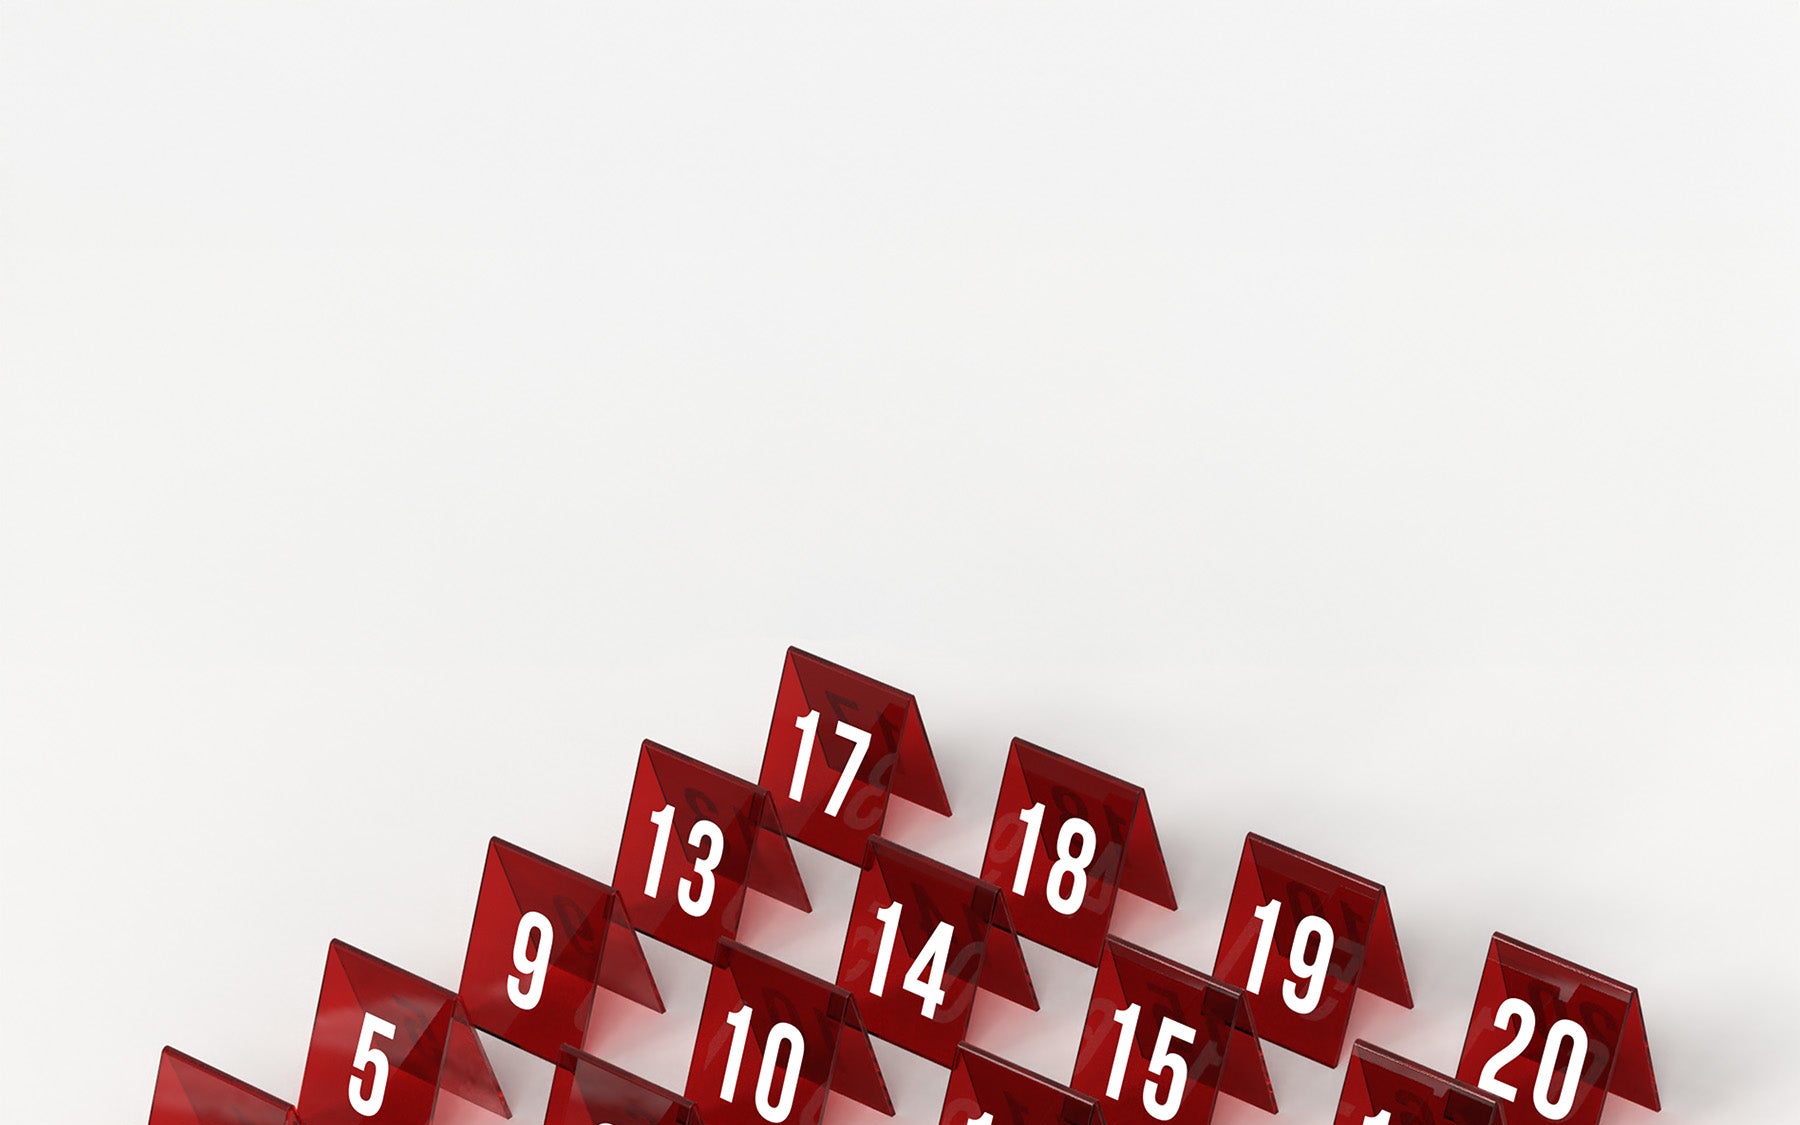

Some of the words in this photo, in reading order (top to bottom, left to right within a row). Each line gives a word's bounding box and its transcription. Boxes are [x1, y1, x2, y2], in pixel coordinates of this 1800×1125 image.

[788, 709, 872, 817] 17
[644, 804, 724, 917] 13
[1012, 802, 1097, 915] 18
[506, 911, 554, 1010] 9
[869, 901, 955, 1020] 14
[1245, 898, 1335, 1015] 19
[348, 1011, 397, 1117] 5
[719, 1005, 805, 1124] 10
[1105, 1002, 1197, 1121] 15
[1477, 997, 1588, 1121] 20
